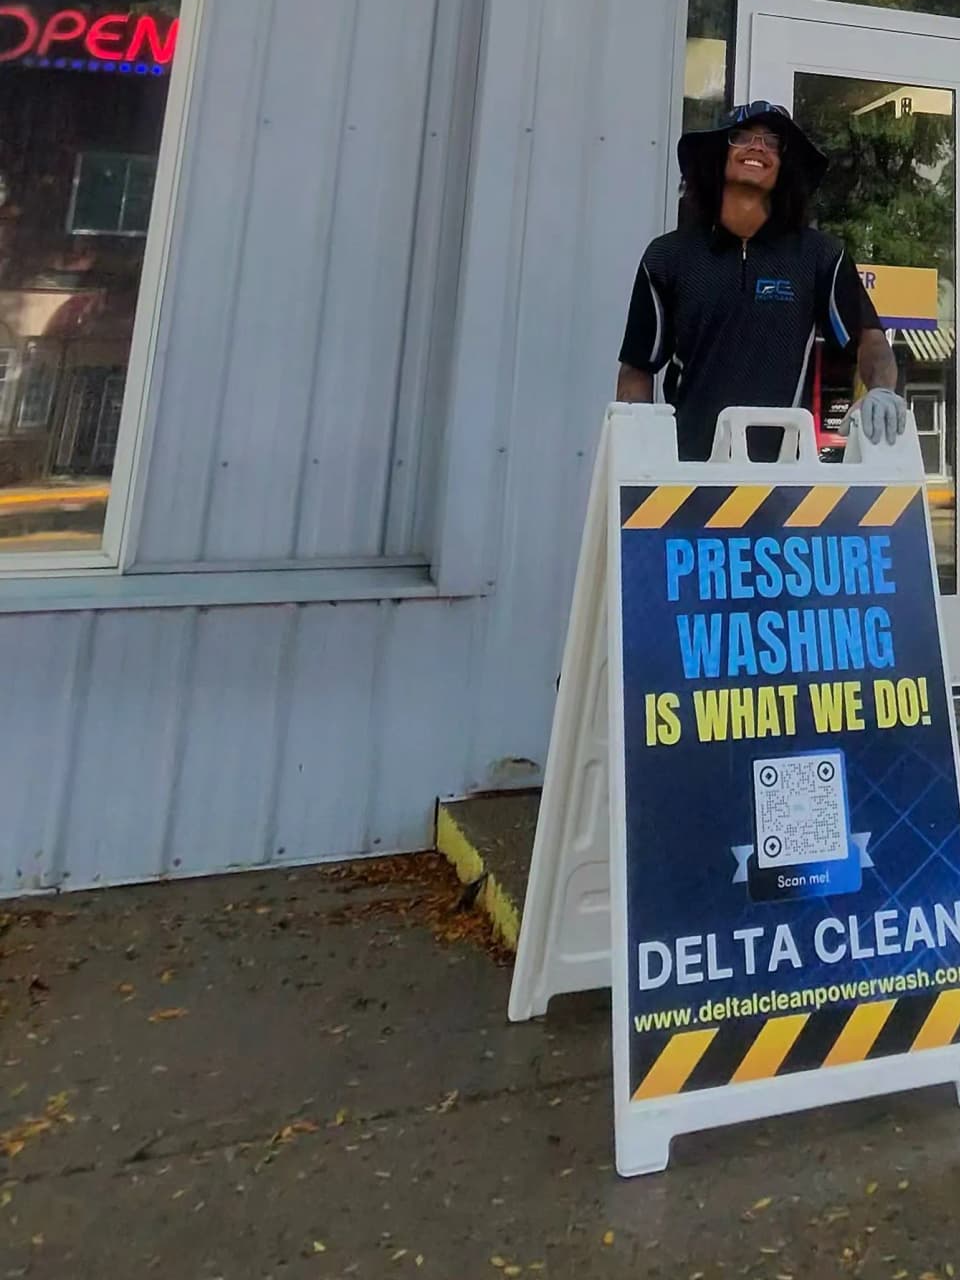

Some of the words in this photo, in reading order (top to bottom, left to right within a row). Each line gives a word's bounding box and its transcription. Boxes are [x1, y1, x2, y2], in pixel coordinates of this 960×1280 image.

[665, 535, 896, 602] PRESSURE
[677, 606, 896, 680] WASHING
[644, 692, 682, 747] IS
[693, 684, 799, 743] WHAT
[808, 680, 866, 734] WE
[873, 676, 932, 729] DO!
[777, 875, 807, 889] Scan
[638, 923, 802, 991] DELTA
